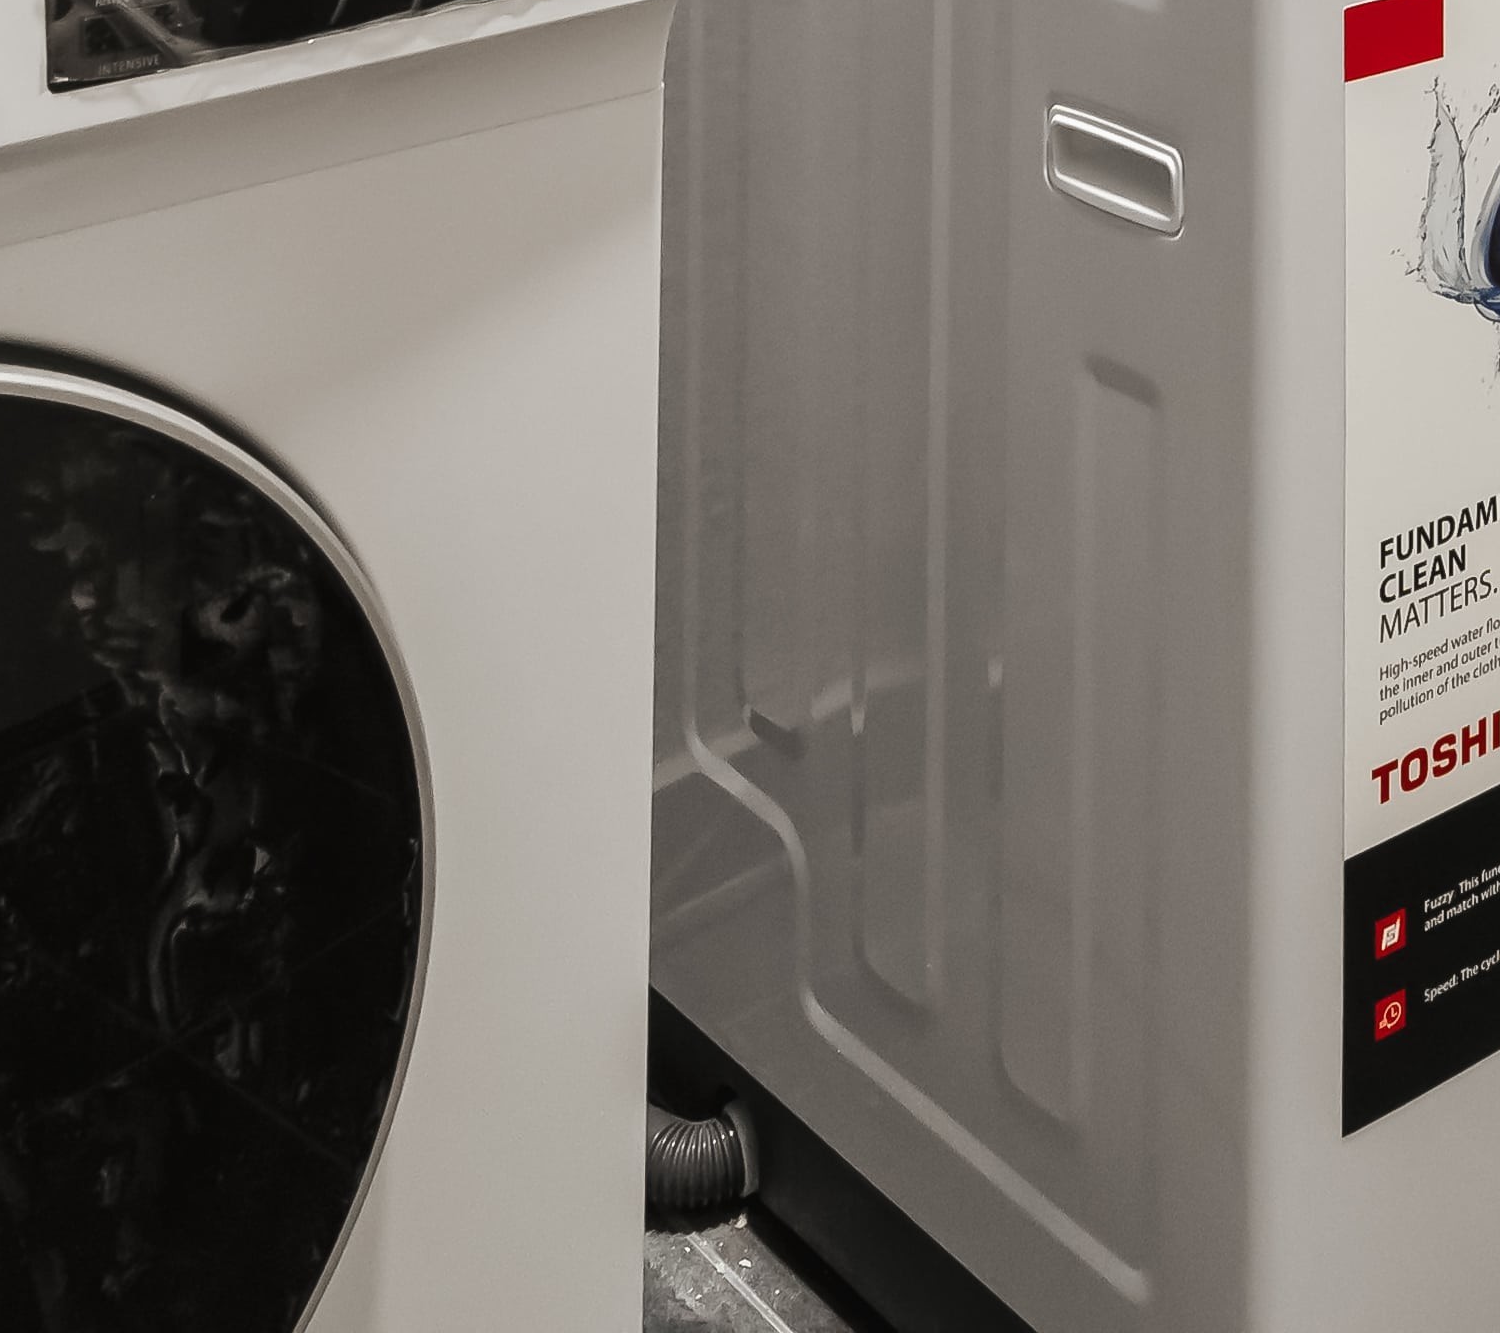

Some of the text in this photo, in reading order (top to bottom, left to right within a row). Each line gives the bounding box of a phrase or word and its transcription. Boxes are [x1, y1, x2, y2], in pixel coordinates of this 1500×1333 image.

[1379, 544, 1466, 603] CLEAN
[1380, 569, 1498, 643] MATTERS.
[1380, 639, 1448, 681] High-speed
[1451, 626, 1484, 650] water
[1380, 683, 1399, 701] the
[1402, 669, 1434, 691] inner
[1436, 657, 1459, 677] and
[1461, 644, 1492, 666] outer
[1380, 688, 1434, 725] pollution
[1437, 676, 1450, 696] of
[1451, 668, 1470, 689] the
[1424, 910, 1444, 931] and
[1446, 891, 1479, 919] match
[1459, 875, 1479, 894] This
[1460, 962, 1479, 982] The
